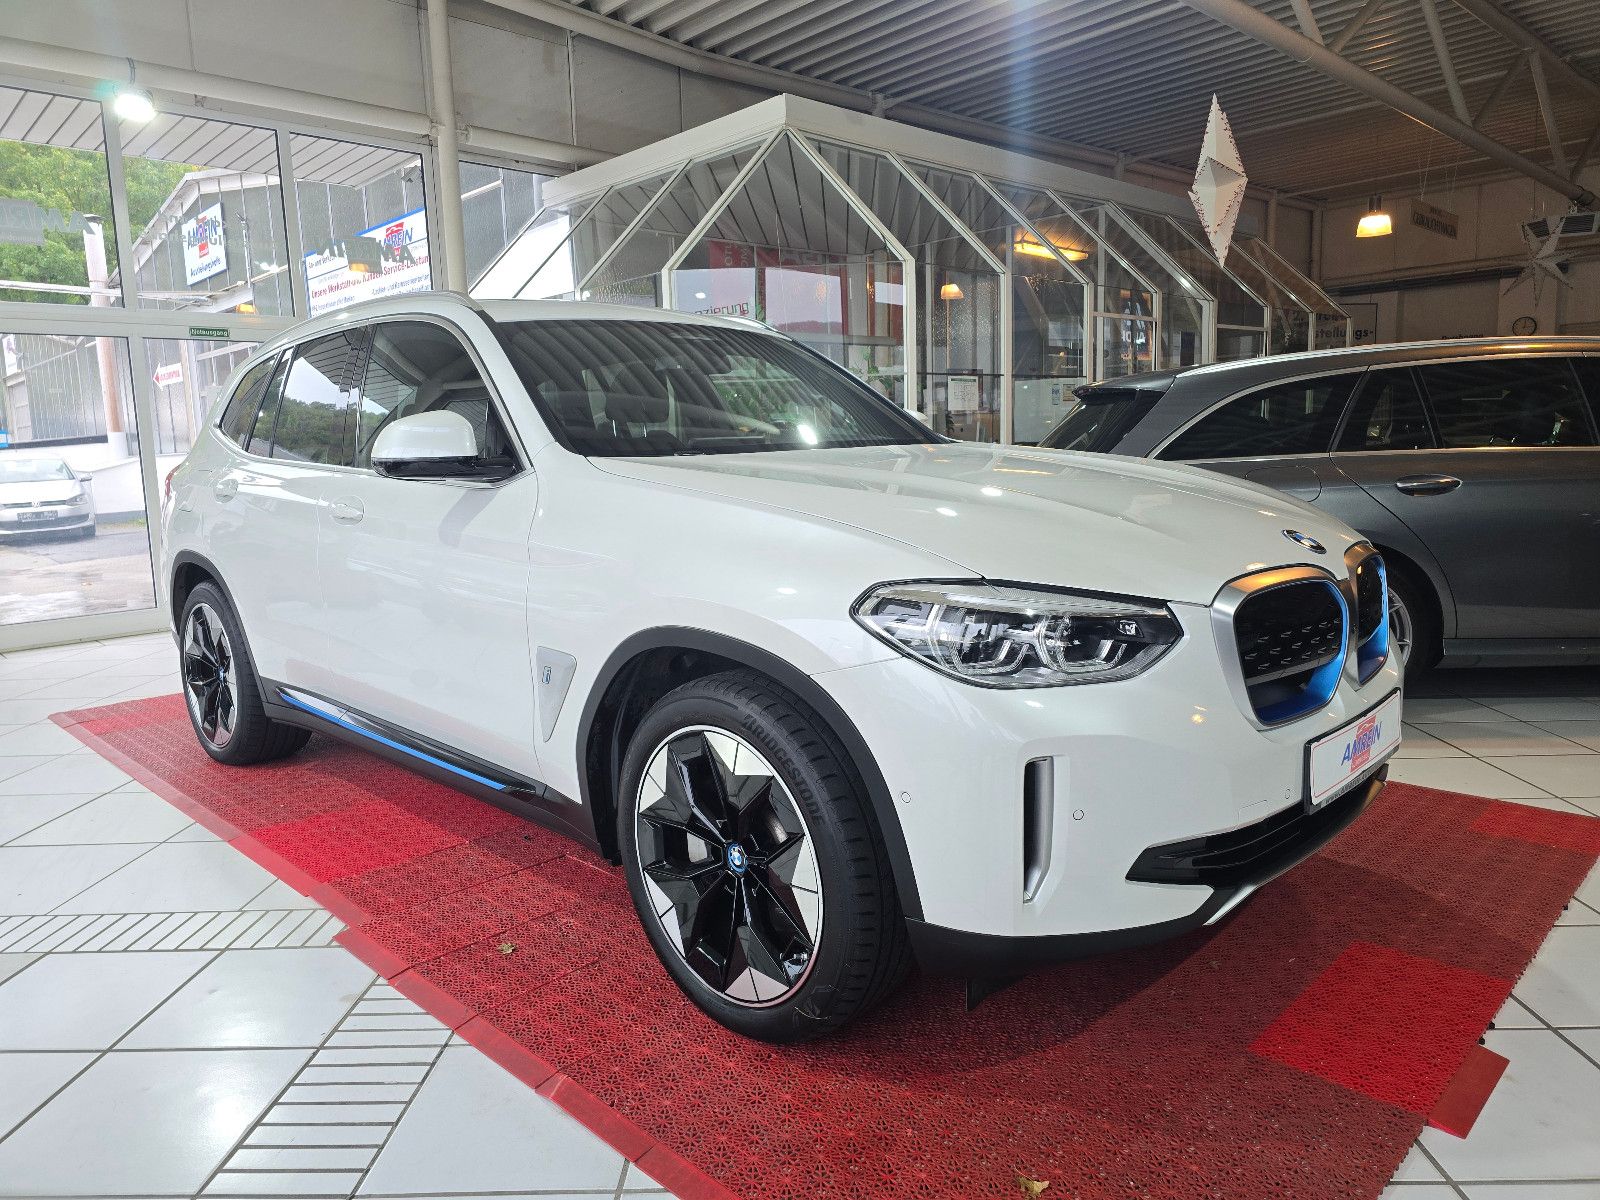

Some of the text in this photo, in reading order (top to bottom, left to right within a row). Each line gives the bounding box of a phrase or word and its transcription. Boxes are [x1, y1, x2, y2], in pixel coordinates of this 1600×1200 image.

[191, 328, 228, 337] Notausgang
[1341, 721, 1383, 766] AMREIN
[742, 713, 826, 826] BRIDGESTONE
